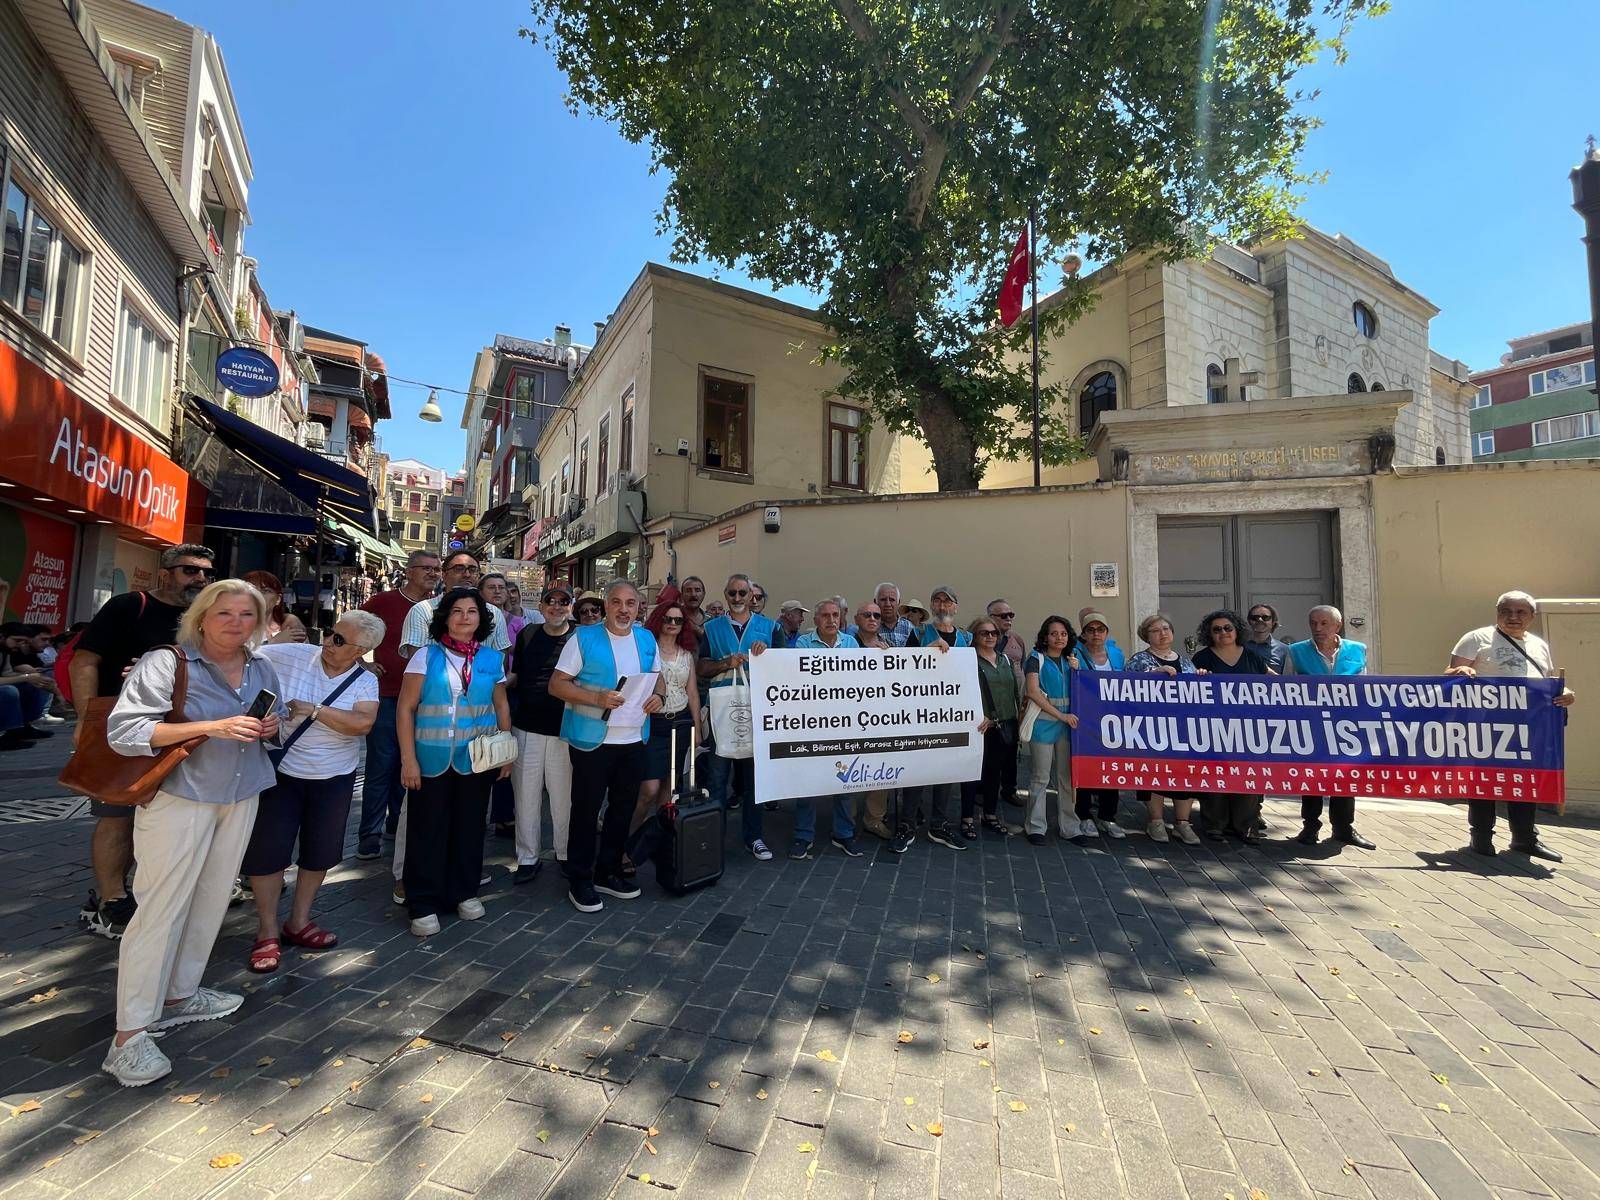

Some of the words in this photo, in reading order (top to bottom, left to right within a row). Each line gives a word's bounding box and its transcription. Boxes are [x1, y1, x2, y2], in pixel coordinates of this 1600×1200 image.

[221, 367, 274, 382] RESTAURANT
[232, 363, 264, 374] HAYYAM
[50, 417, 133, 500] Atasun
[138, 468, 179, 522] Optik
[33, 551, 64, 571] Atasun
[31, 588, 59, 608] gözler
[24, 607, 60, 624] üstünde
[799, 655, 878, 676] Eğitimde
[883, 655, 907, 670] Bir
[912, 655, 936, 670] Yıl:
[766, 684, 886, 707] Çözülemeyen
[891, 681, 961, 698] Sorunlar
[1099, 678, 1215, 704] MAHKEME
[1220, 681, 1358, 707] KARARLARI
[1364, 683, 1528, 710] UYGULANSIN
[763, 713, 851, 731] Ertelenen
[857, 709, 911, 731] Çocuk
[916, 708, 974, 724] Hakları
[1100, 714, 1315, 756] OKULUMUZU
[1321, 711, 1532, 760] İSTİYORUZ!
[1101, 761, 1172, 773] İSMAİL
[1188, 765, 1272, 777] TARMAN
[1288, 768, 1417, 780] ORTAOKULU
[1431, 771, 1537, 783] VELİLERİ
[1102, 775, 1226, 789] KONAKLAR
[1245, 780, 1385, 793] MAHALLESİ
[1404, 784, 1537, 798] SAKİNLERİ
